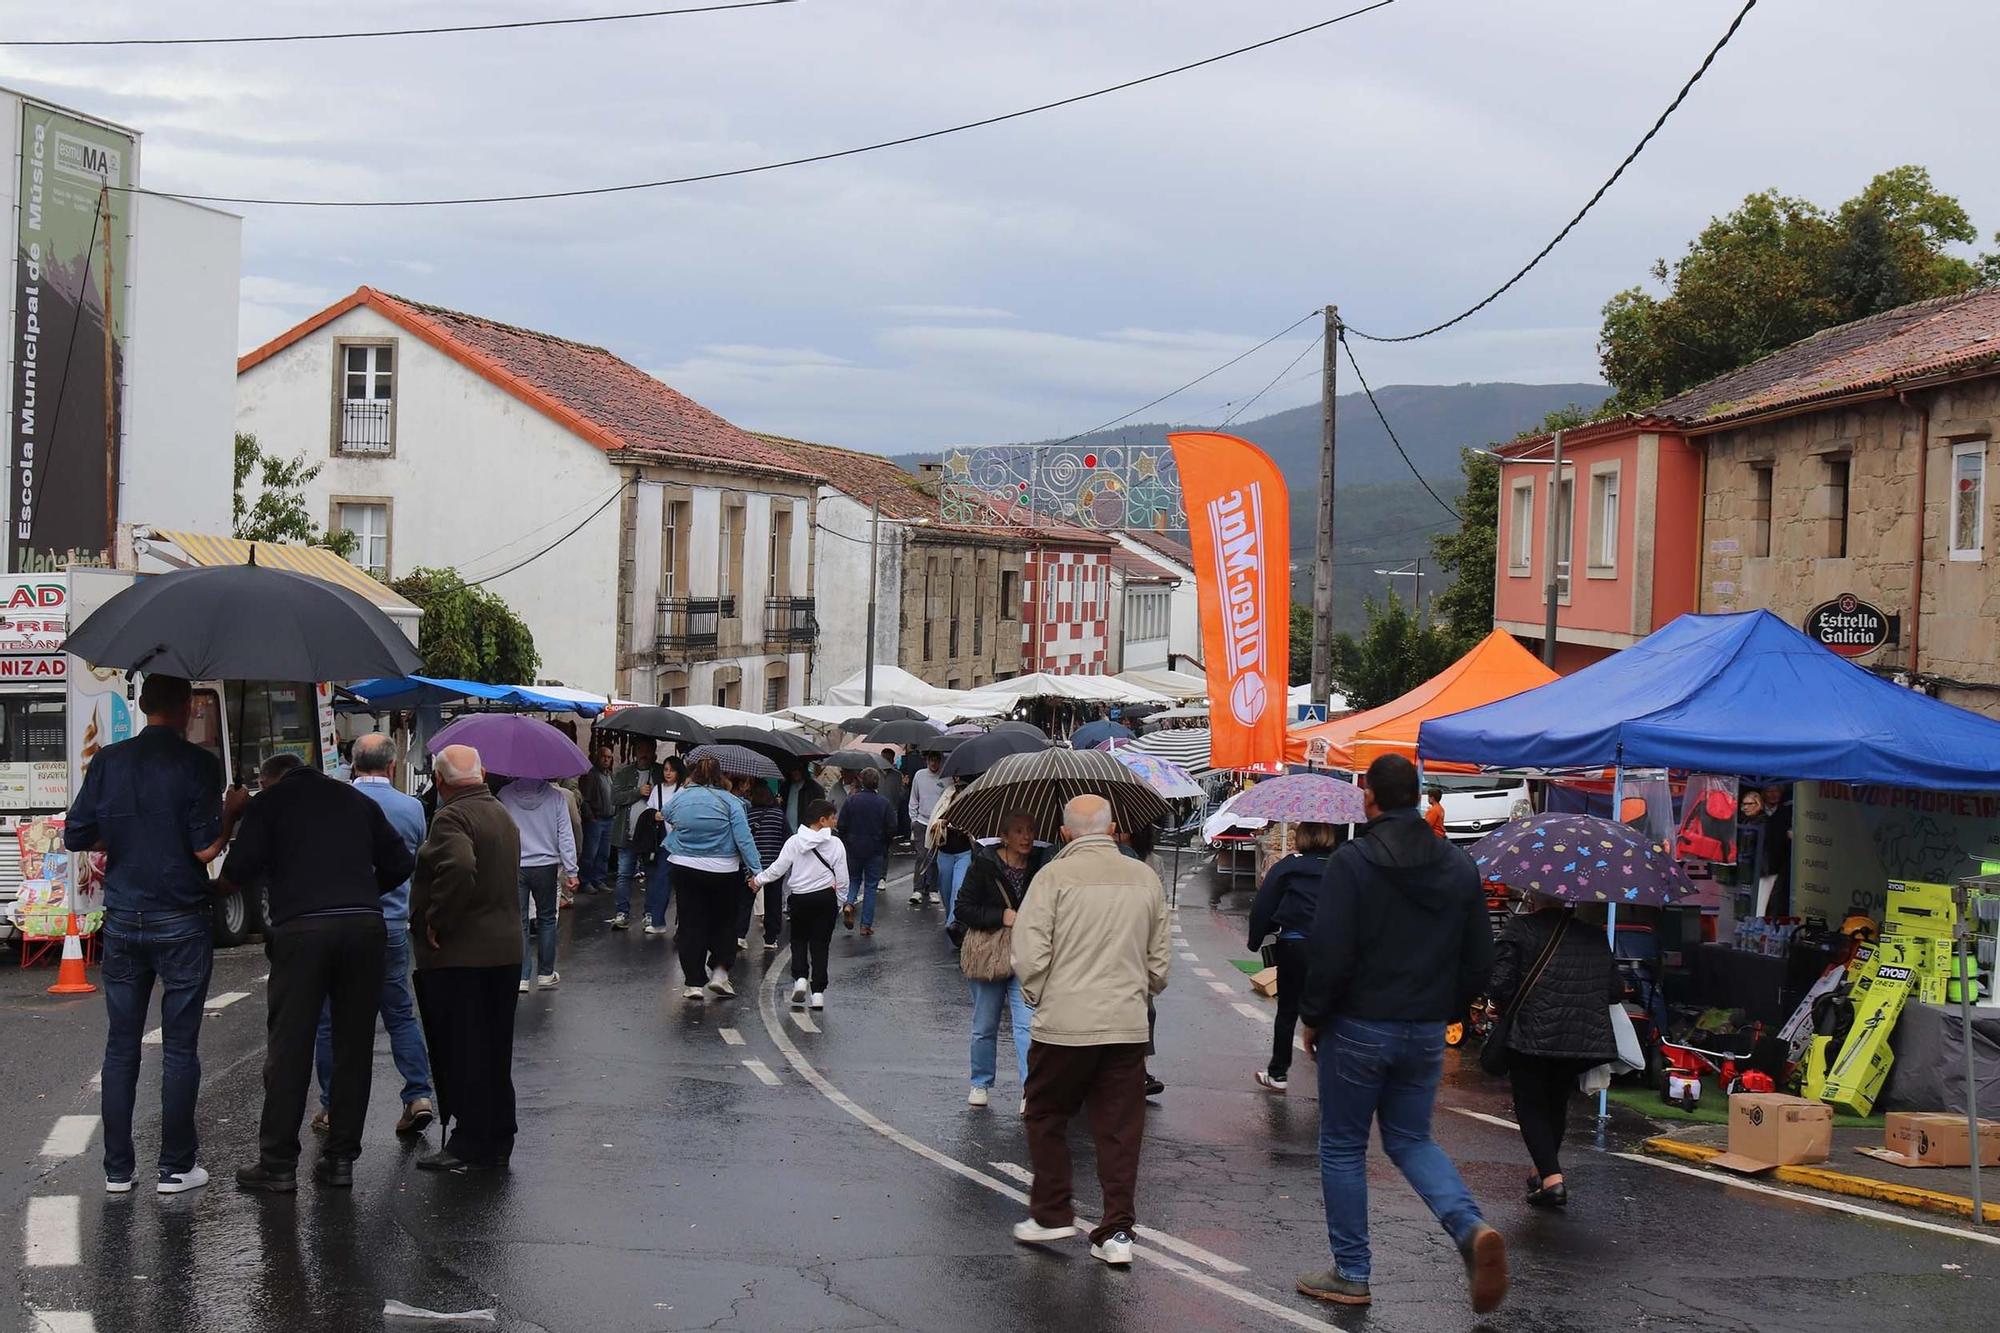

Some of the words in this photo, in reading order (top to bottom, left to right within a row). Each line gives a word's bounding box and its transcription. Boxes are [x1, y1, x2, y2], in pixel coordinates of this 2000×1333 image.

[29, 124, 45, 231] Música
[27, 243, 41, 281] de
[21, 286, 41, 435] Municipal
[18, 442, 34, 540] Escola
[0, 584, 67, 608] AD
[1818, 611, 1878, 628] Estrella
[1820, 627, 1875, 643] Galicia
[1, 660, 66, 675] NIZAD
[1878, 966, 1909, 979] RYOBI
